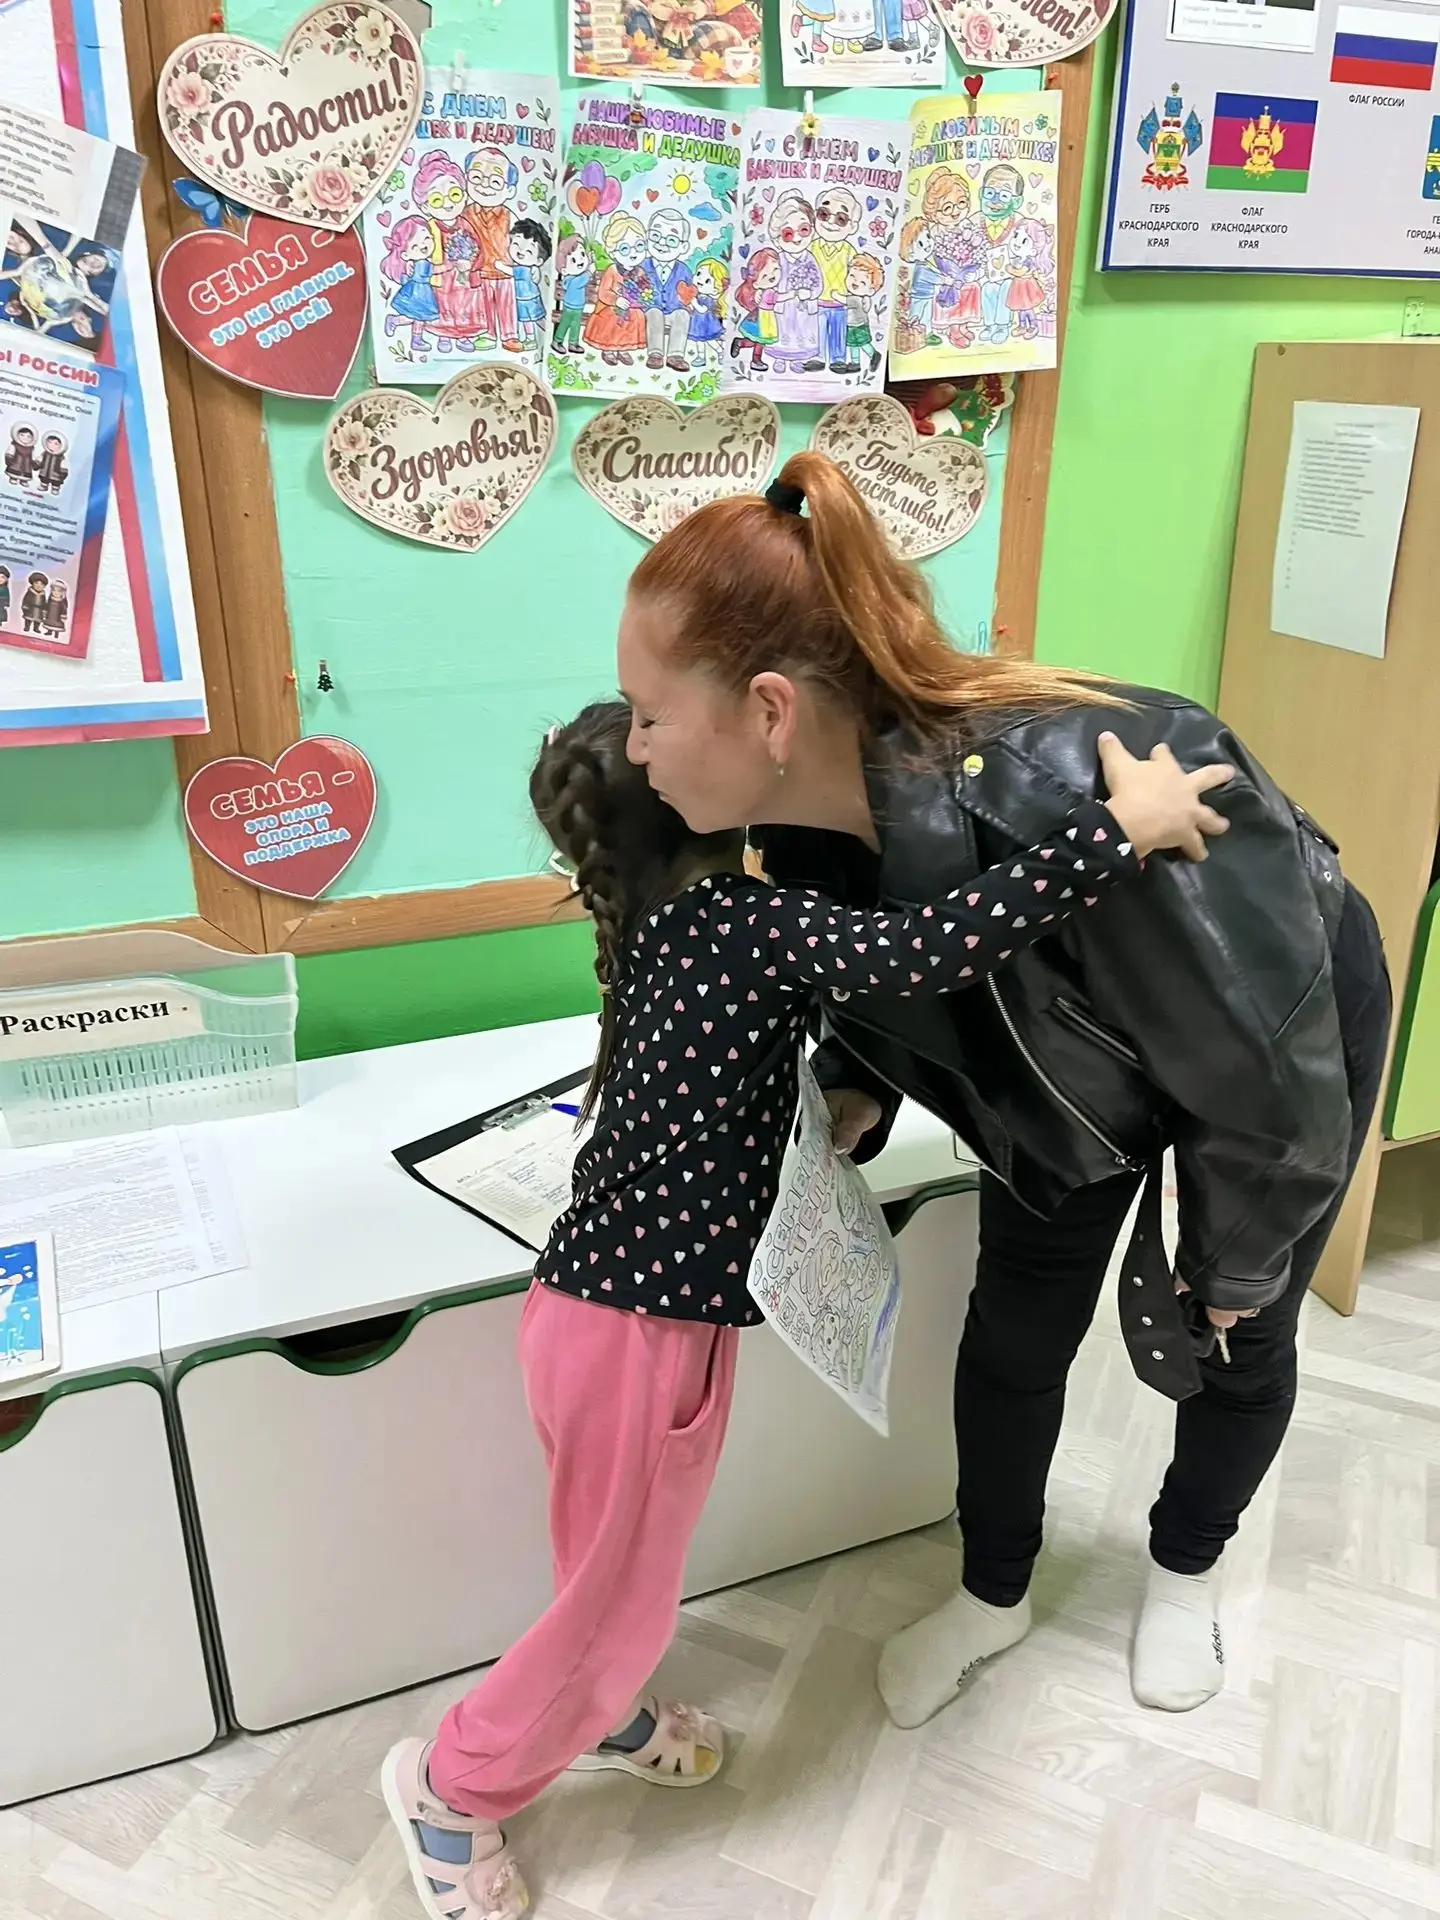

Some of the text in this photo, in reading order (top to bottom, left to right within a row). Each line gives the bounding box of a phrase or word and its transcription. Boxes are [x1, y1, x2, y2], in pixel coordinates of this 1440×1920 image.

[211, 58, 408, 170] Радости!
[588, 99, 630, 126] НАШИ
[1349, 94, 1405, 107] ФЛАГ РОССИИ
[455, 121, 467, 139] И
[471, 121, 556, 153] ДЕДУШЕК!
[783, 134, 796, 157] С
[930, 115, 1020, 143] ЛЮБИМЫМ
[572, 123, 741, 169] БАБУШКА И ДЕДУШКА
[966, 140, 977, 159] И
[979, 138, 1057, 164] ДЕДУШКЕ!
[746, 158, 903, 192] БАБУШЕК И ДЕДУШЕК!
[1149, 203, 1170, 214] ГЕРБ
[1241, 207, 1264, 217] ФЛАГ
[1118, 220, 1200, 232] КРАСНОДАРСКОГО
[1210, 222, 1288, 234] КРАСНОДАРСКОГО
[1147, 238, 1170, 248] КРАЯ
[1238, 239, 1259, 249] КРАЯ
[188, 233, 308, 315] СЕМЬЯ
[209, 317, 247, 346] ЭТО
[244, 303, 274, 328] НЕ
[256, 297, 333, 348] ЭТО ВСЁ!
[19, 353, 98, 386] РОССИИ
[370, 412, 542, 502] Здоровья!
[602, 433, 763, 484] Спасибо!
[856, 440, 938, 497] Будьте
[210, 771, 326, 820] СЕМЬЯ
[244, 801, 333, 834] ЭТО НАША
[256, 817, 330, 847] ОПОРА И
[243, 828, 351, 865] ПОДДЕРЖКА
[0, 1000, 170, 1036] Раскраски
